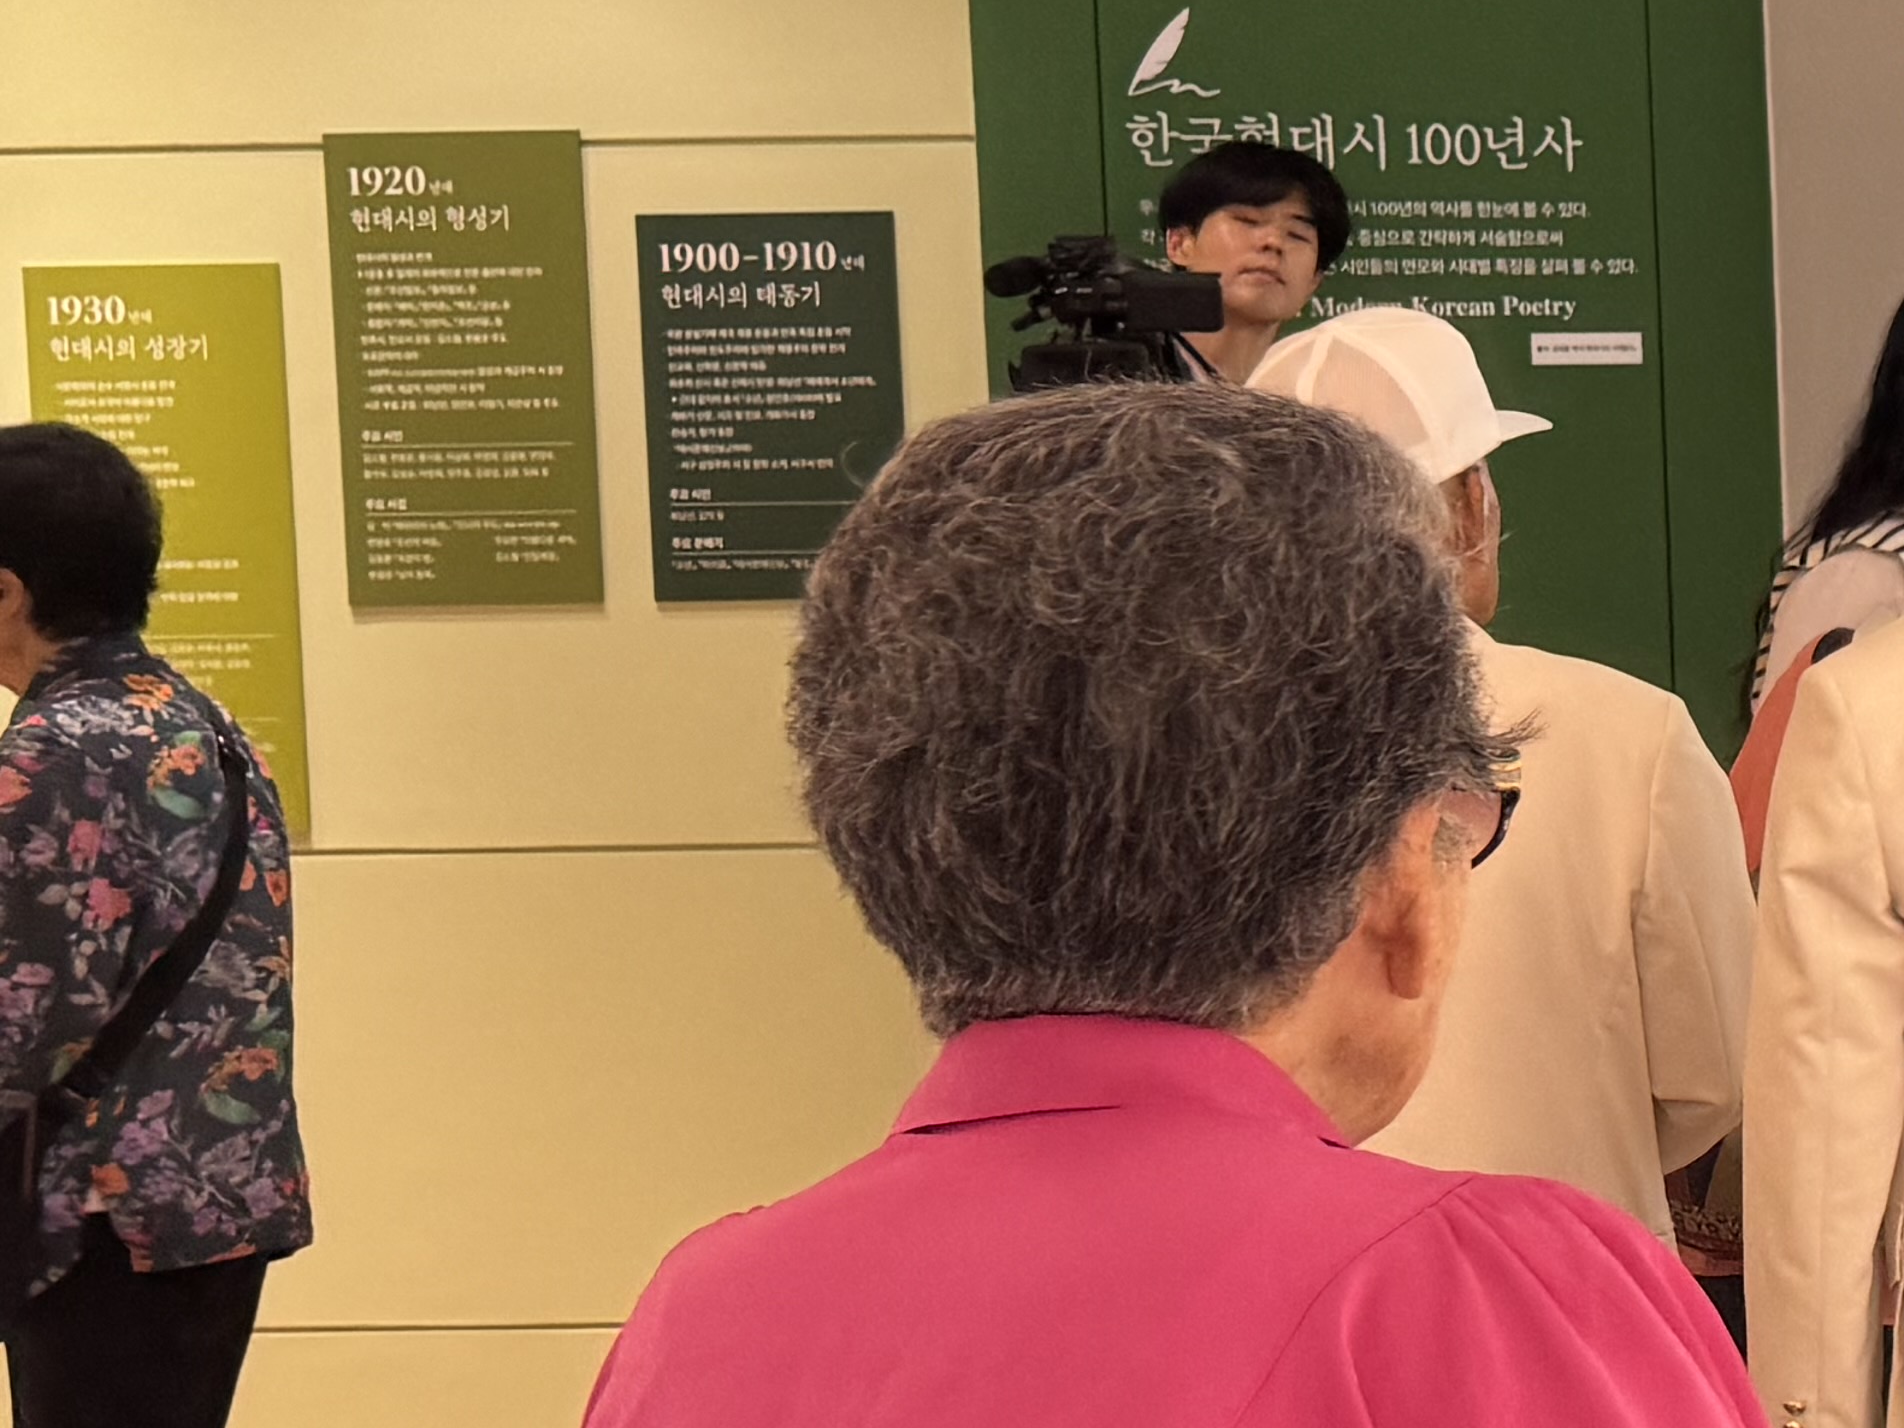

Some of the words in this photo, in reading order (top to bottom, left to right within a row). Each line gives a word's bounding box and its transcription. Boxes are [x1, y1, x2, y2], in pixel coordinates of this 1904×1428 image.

[1405, 114, 1584, 173] 100년사
[350, 204, 438, 233] 현대시의
[445, 204, 510, 232] 형성기
[1370, 199, 1428, 218] 100년의
[1430, 200, 1473, 219] 역사를
[1541, 201, 1555, 219] 수
[1340, 257, 1400, 276] 시인들의
[1590, 258, 1604, 276] 수
[661, 282, 748, 310] 현대시의
[756, 281, 821, 308] 태동기
[1411, 296, 1496, 317] Korean
[1502, 295, 1577, 321] Poetry
[50, 335, 136, 362] 현대시의
[145, 334, 209, 361] 성장기
